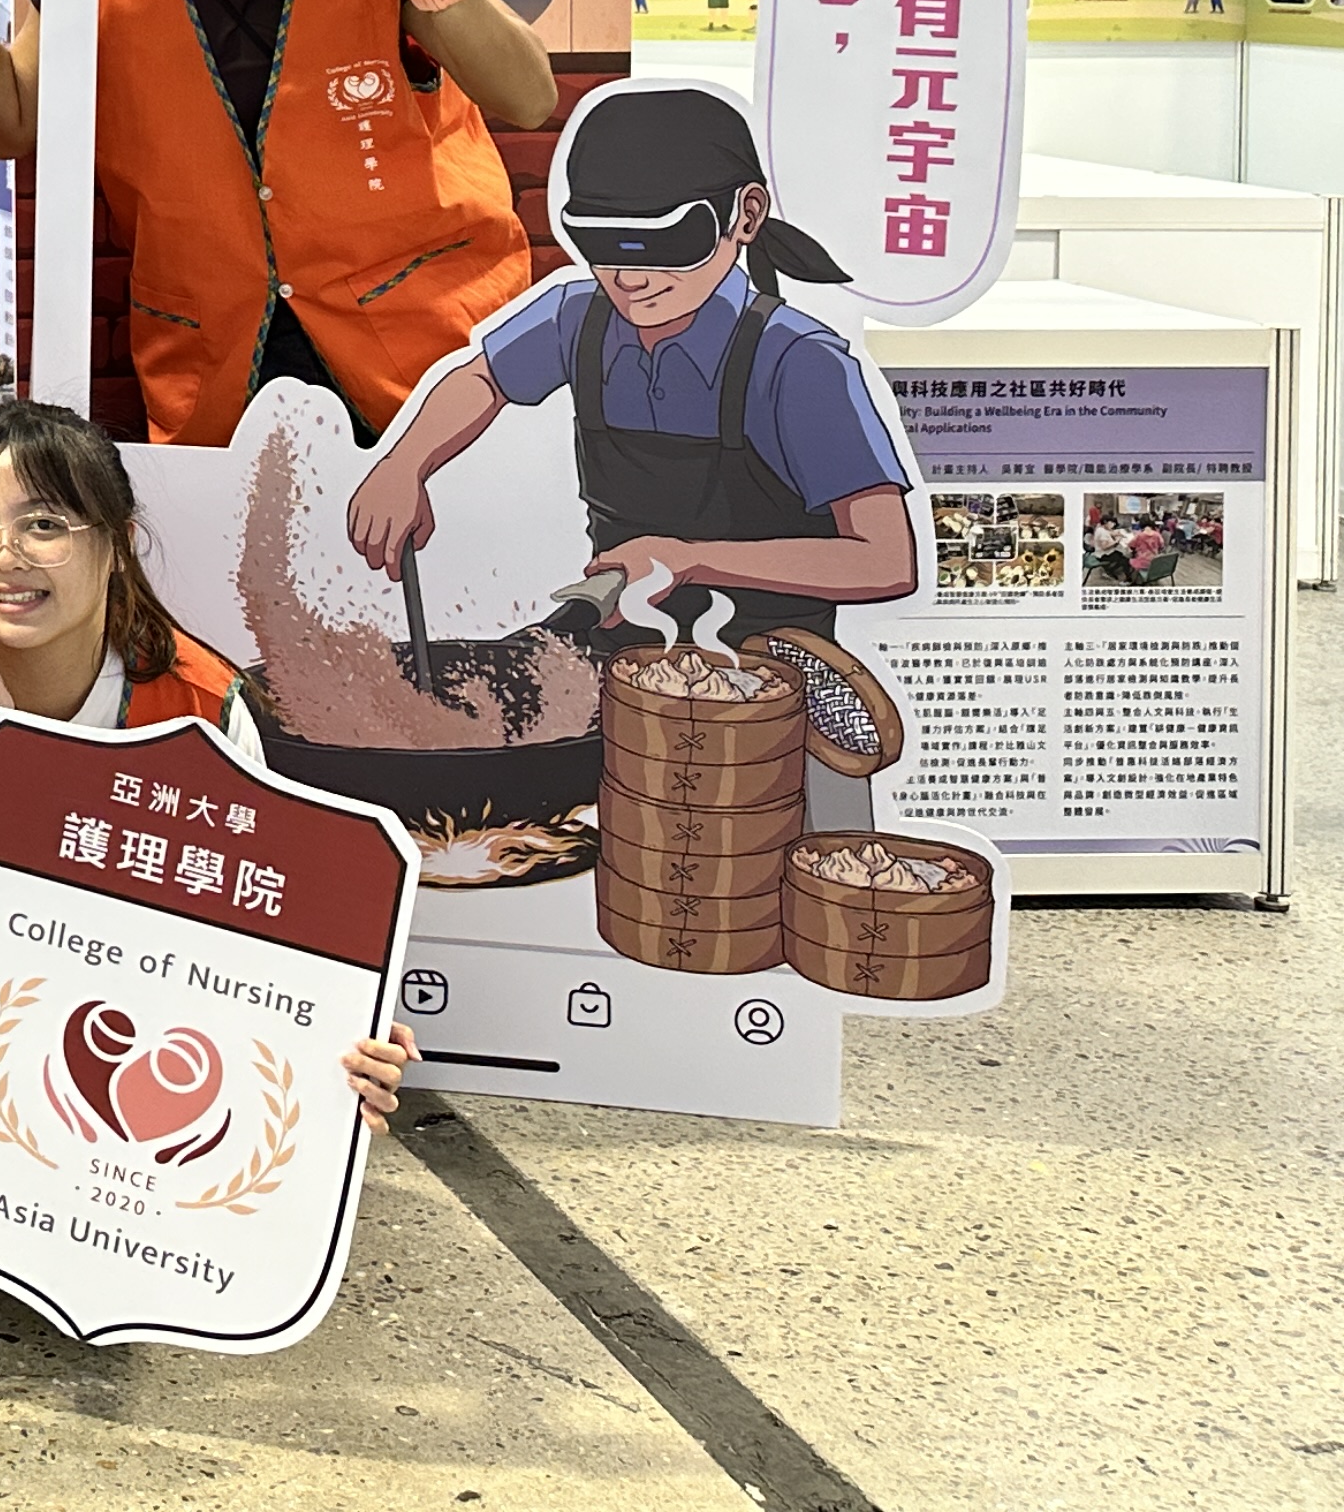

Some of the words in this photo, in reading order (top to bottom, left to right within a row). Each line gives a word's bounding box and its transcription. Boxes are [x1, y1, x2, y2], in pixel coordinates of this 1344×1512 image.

[892, 379, 1126, 399] 與科技應用之社區共好時代
[924, 405, 973, 420] Building
[984, 405, 1042, 420] Wellbeing
[1044, 406, 1062, 418] Era
[1064, 406, 1076, 418] in
[1078, 406, 1098, 418] the
[1100, 405, 1168, 420] Community
[920, 422, 993, 437] Applications
[931, 463, 989, 475] 計畫主持人
[110, 772, 257, 837] 亞洲大學
[59, 810, 287, 918] 護理學院
[8, 912, 124, 968] College
[139, 951, 176, 979] of
[188, 963, 317, 1026] Nursing
[89, 1158, 157, 1193] SINCE
[91, 1186, 147, 1217] 2020
[70, 1215, 235, 1294] University
